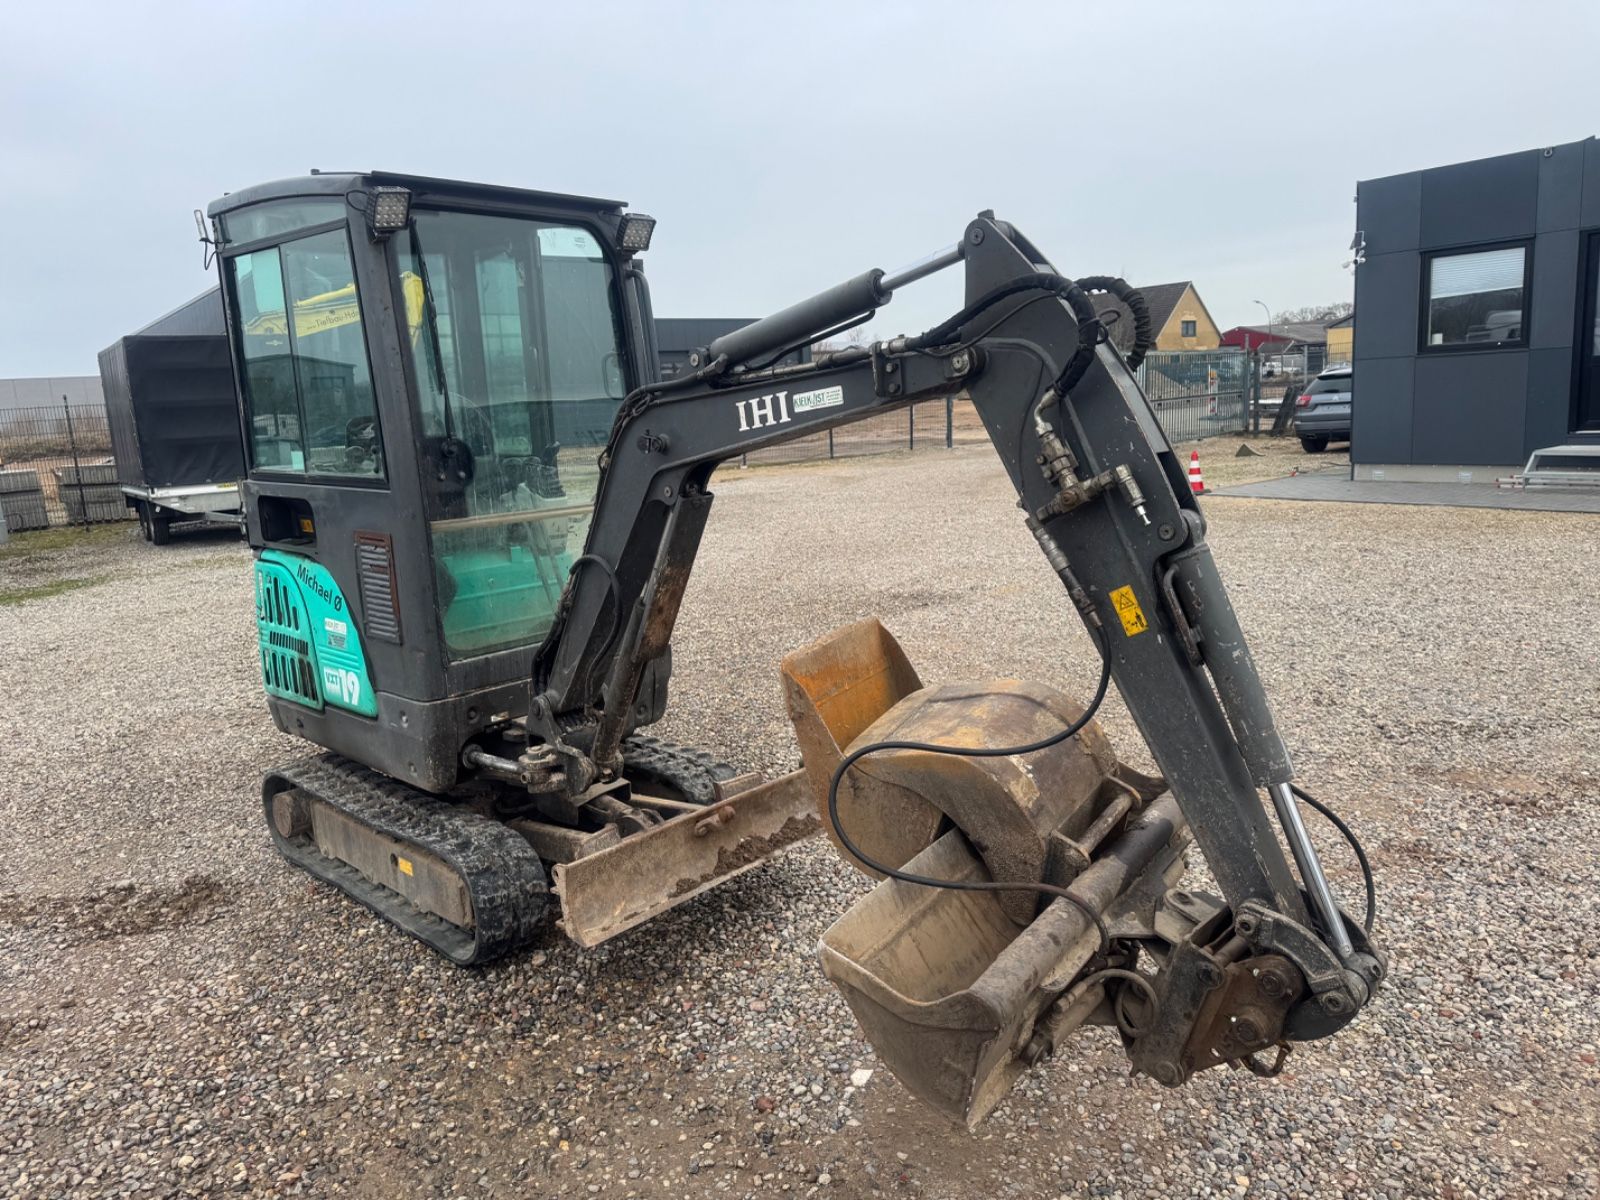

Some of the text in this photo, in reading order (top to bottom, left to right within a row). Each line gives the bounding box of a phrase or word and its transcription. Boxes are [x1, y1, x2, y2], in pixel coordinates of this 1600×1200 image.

[735, 391, 791, 432] IHI
[297, 563, 332, 605] Michael
[338, 668, 360, 706] 19
